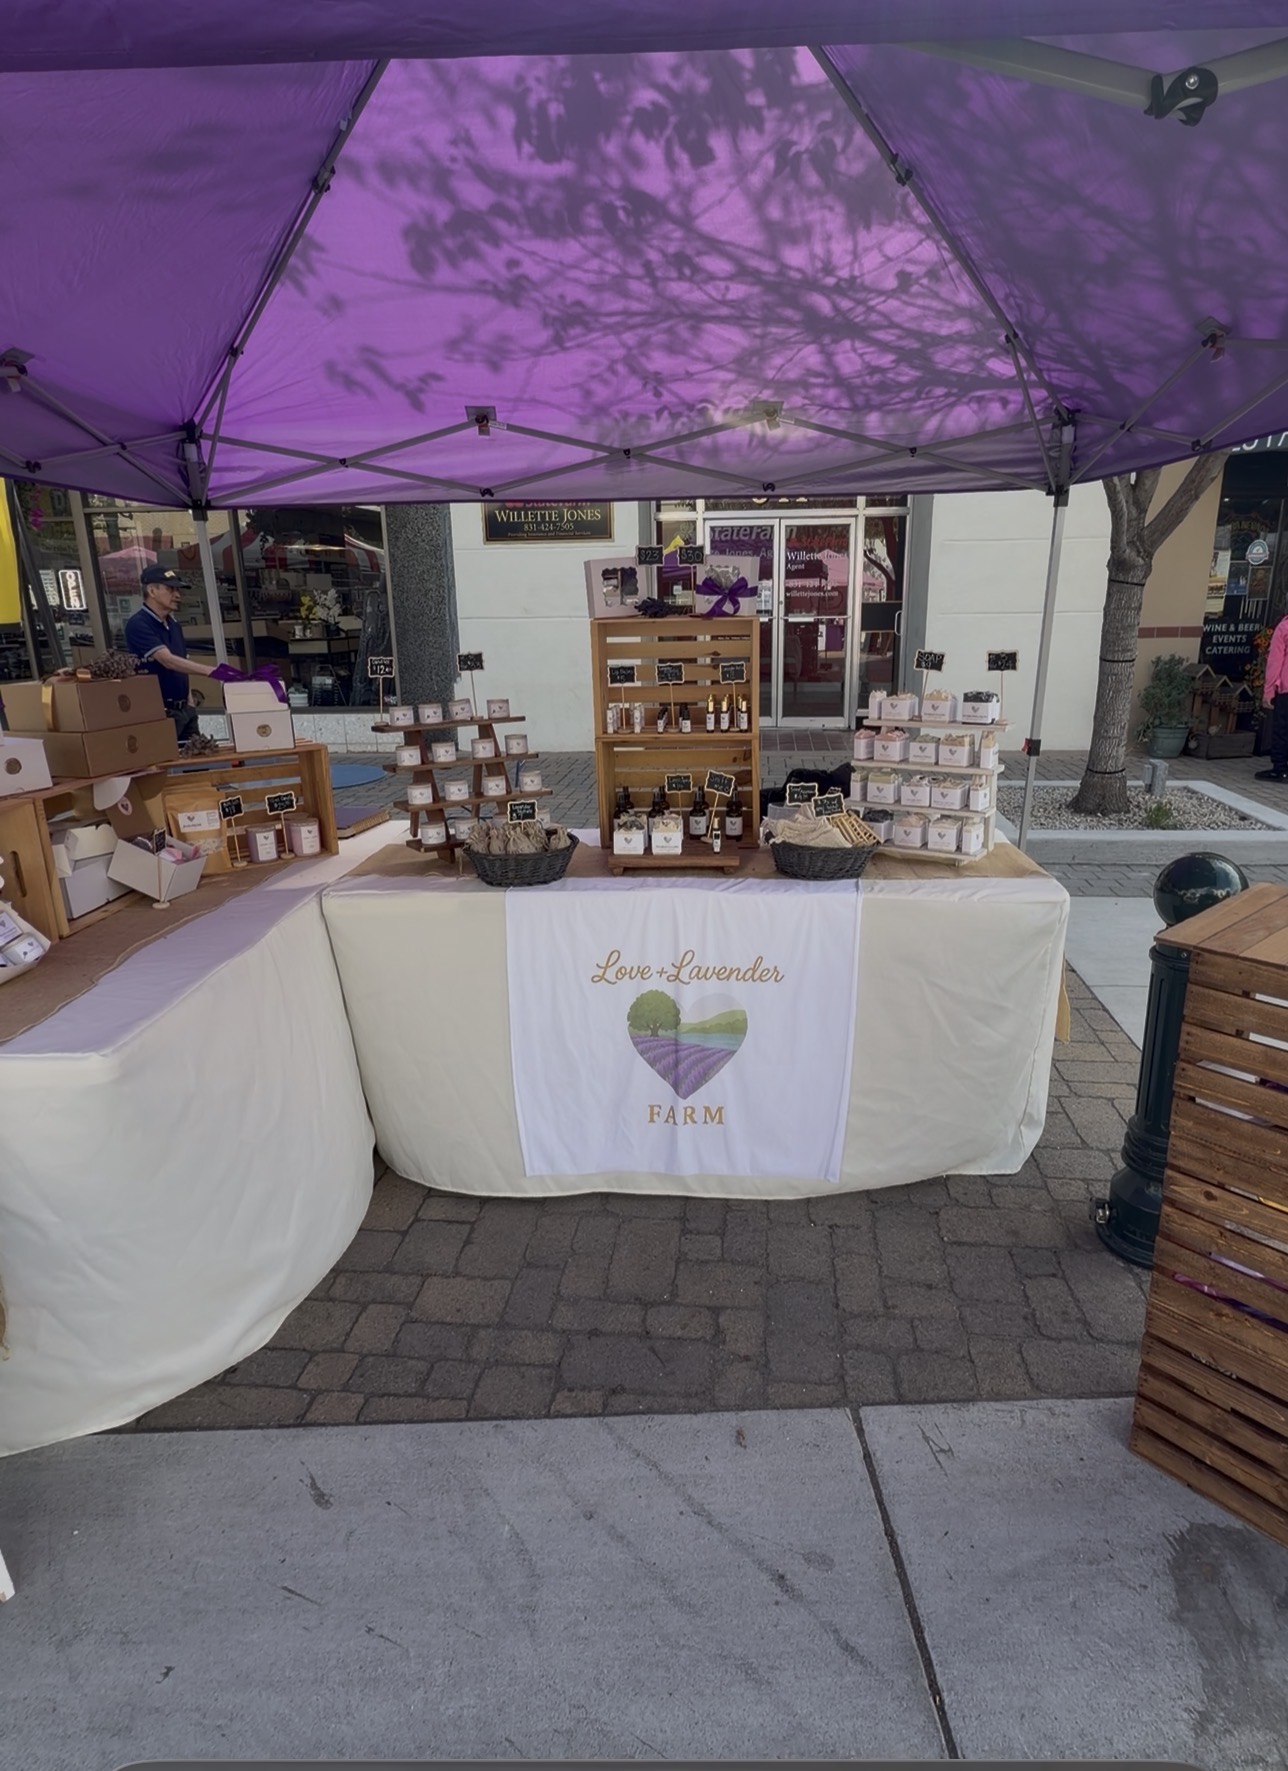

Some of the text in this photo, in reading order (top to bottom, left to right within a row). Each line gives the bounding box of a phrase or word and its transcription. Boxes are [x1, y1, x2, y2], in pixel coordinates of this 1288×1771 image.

[494, 508, 601, 524] WILLETTE JONES
[524, 523, 575, 532] 831-424-7505
[639, 550, 660, 561] $23
[681, 548, 702, 561] $30
[786, 551, 821, 561] Willette
[786, 563, 805, 571] Agent
[65, 572, 81, 608] OPEN
[785, 591, 839, 600] willettejones.com
[1203, 623, 1261, 632] WINE & BEER
[1212, 634, 1247, 643] EVENTS
[1205, 645, 1251, 655] CATERING
[918, 652, 943, 664] SOAP
[590, 949, 653, 985] Love
[666, 949, 785, 985] Lavender
[648, 1104, 725, 1125] FARM
